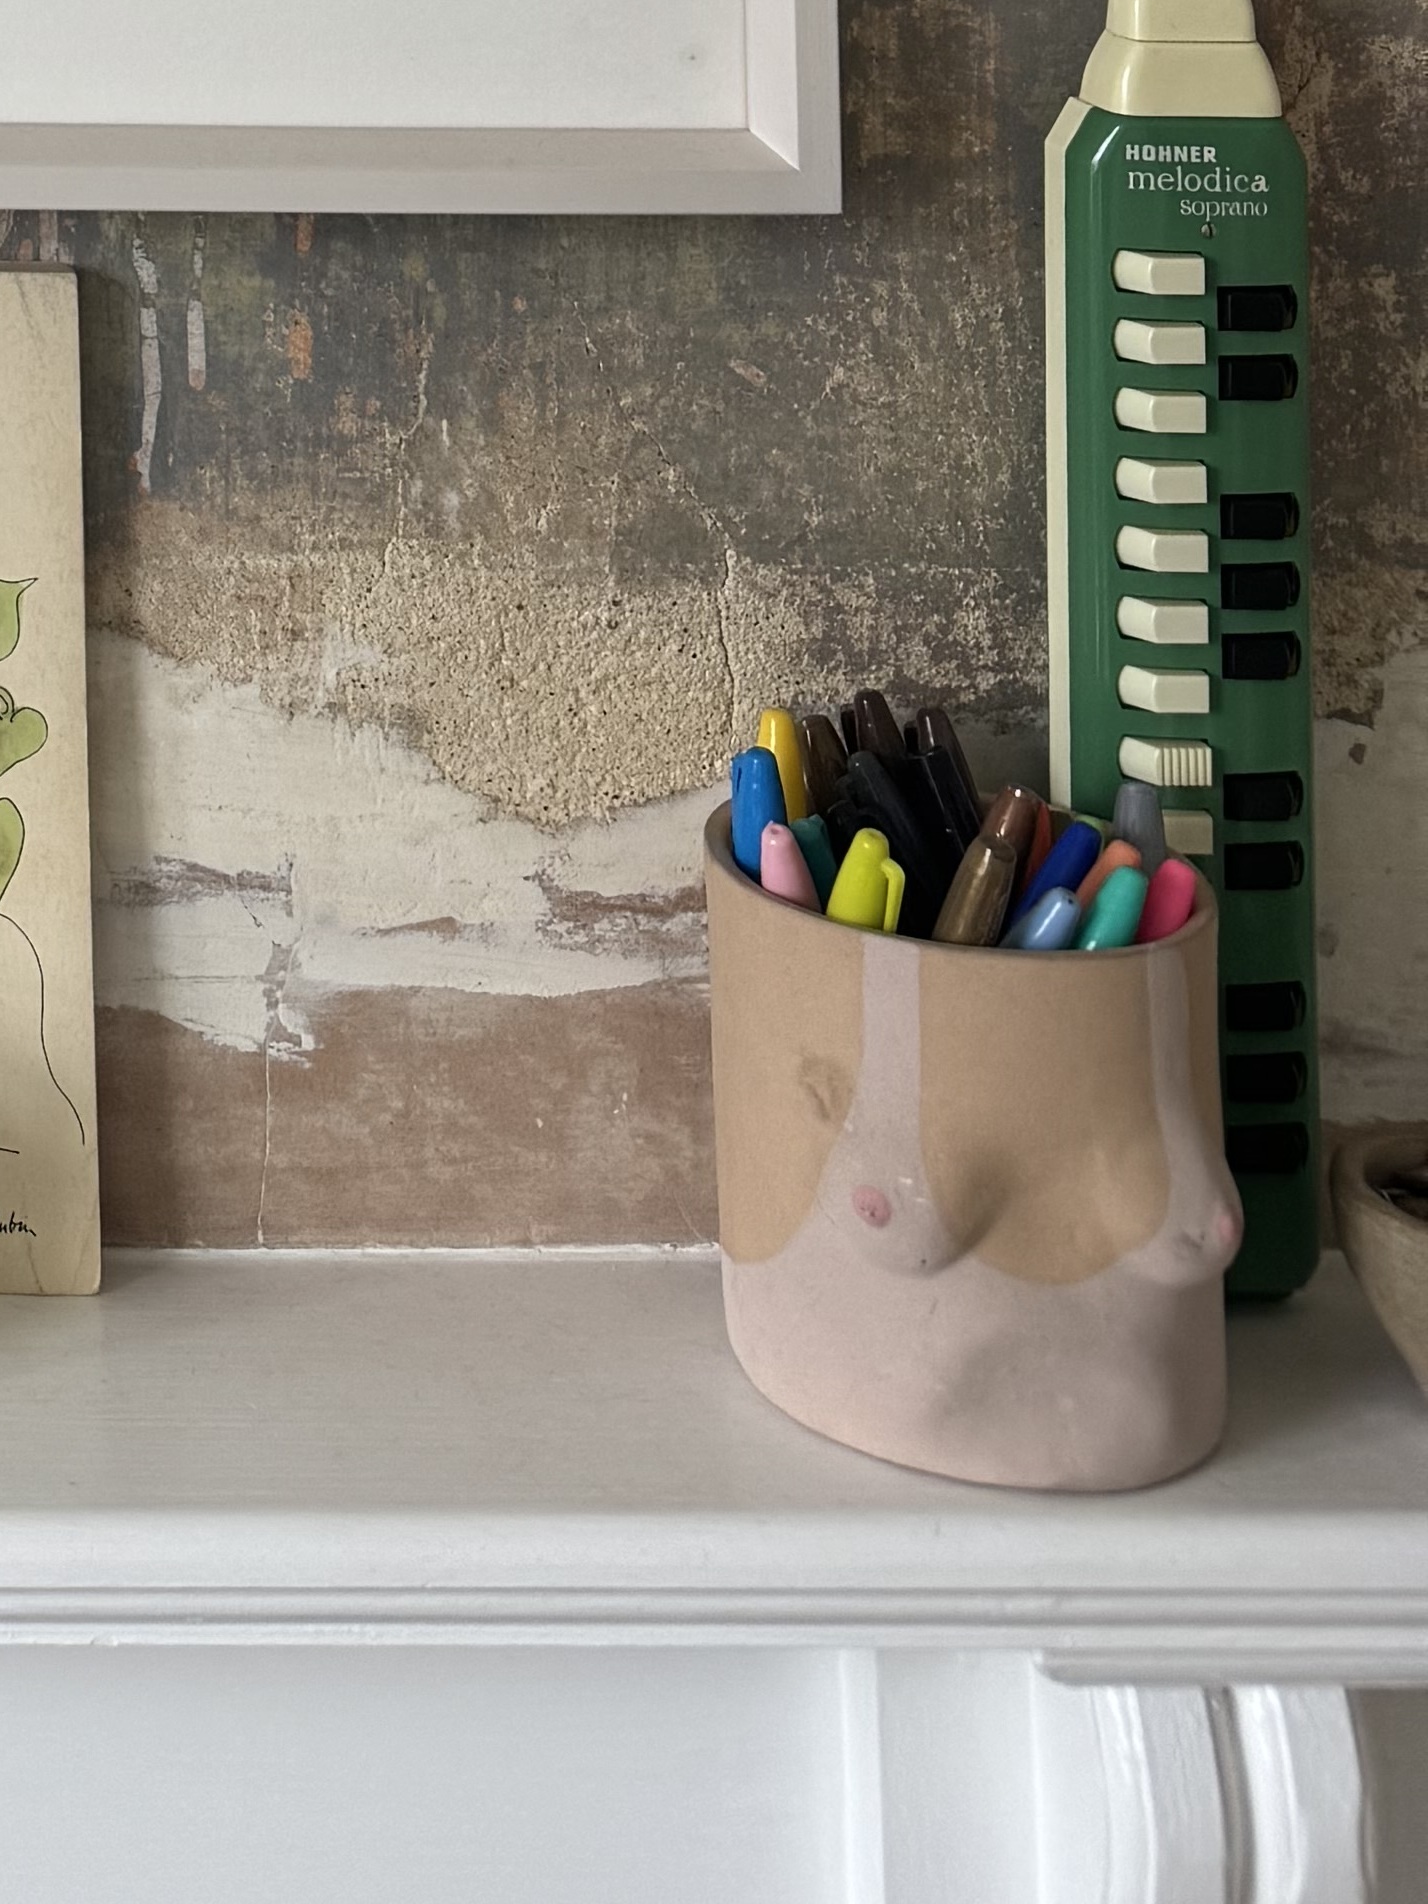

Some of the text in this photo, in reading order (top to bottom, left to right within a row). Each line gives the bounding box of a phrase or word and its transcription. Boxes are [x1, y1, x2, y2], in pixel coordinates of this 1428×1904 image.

[1125, 144, 1217, 164] HOHNER
[1127, 165, 1269, 193] melodica
[1180, 198, 1268, 222] soprano
